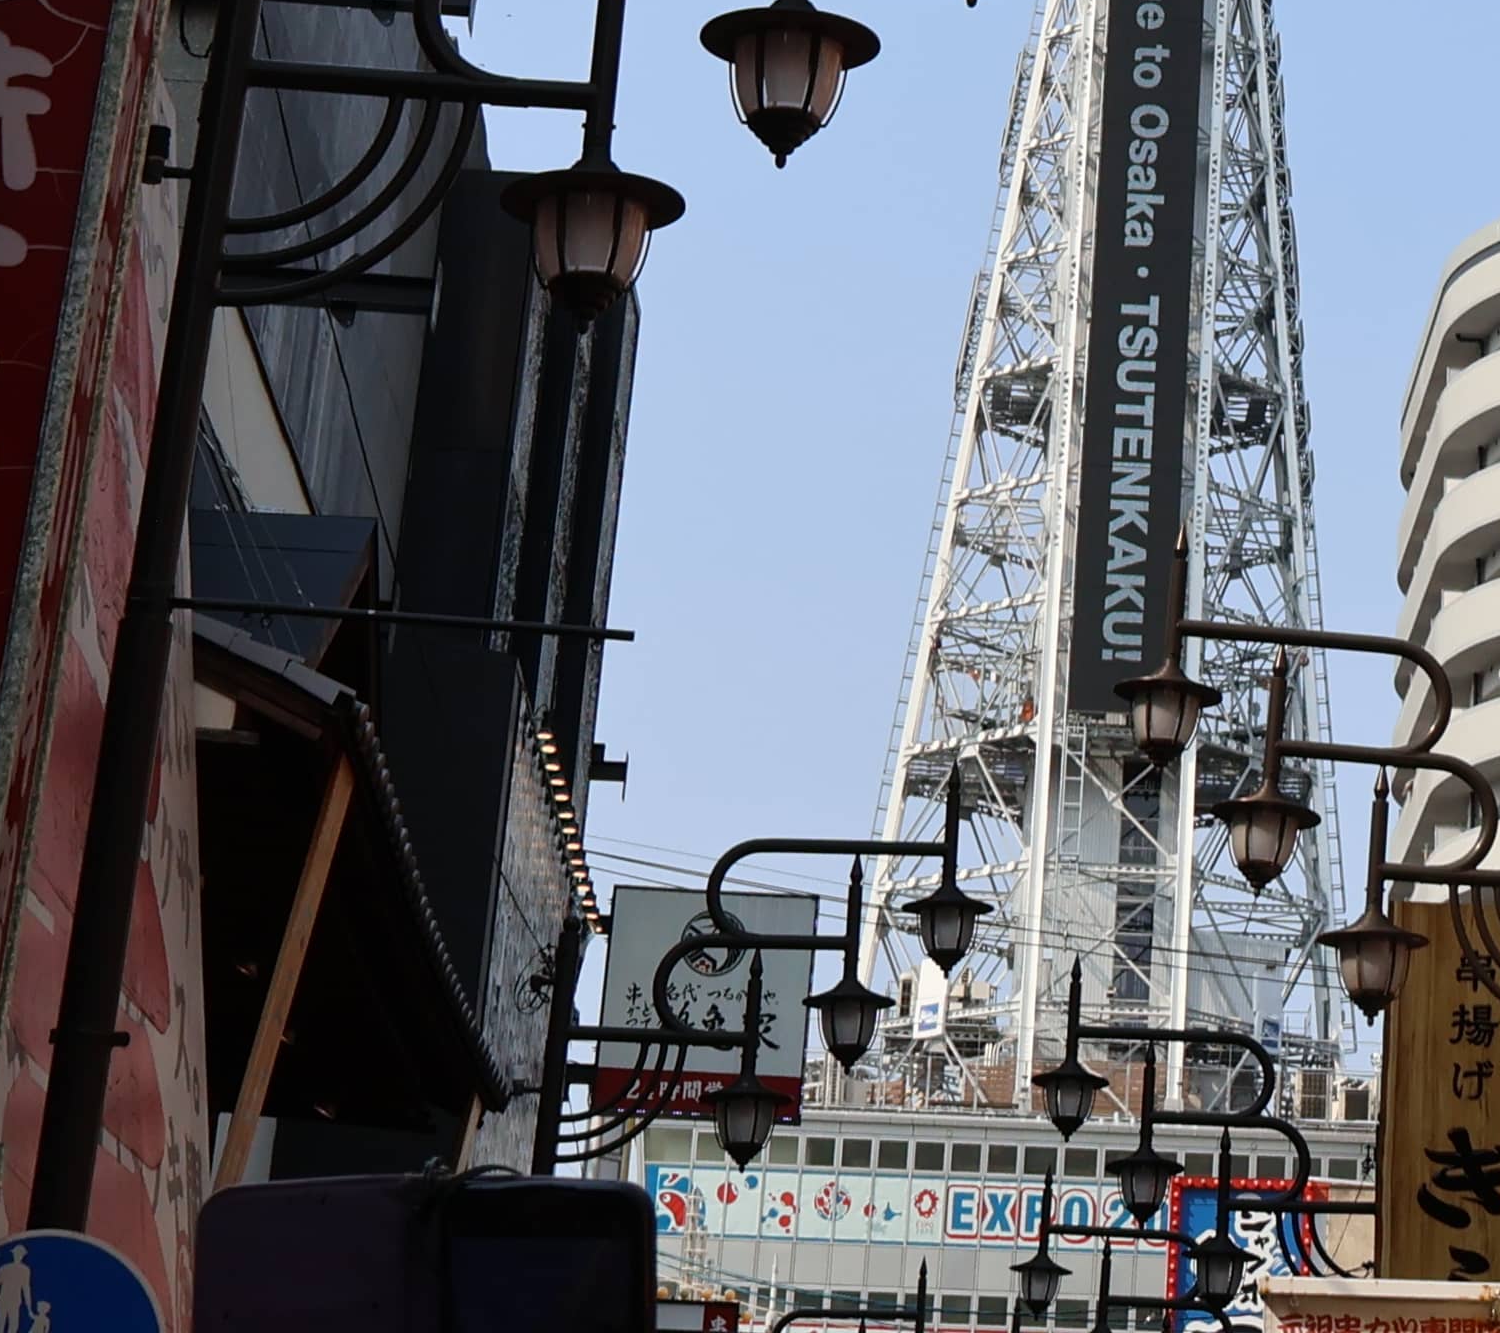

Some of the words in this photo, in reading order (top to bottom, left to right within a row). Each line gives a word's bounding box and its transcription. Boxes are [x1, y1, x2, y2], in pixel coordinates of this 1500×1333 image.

[1133, 44, 1170, 89] to
[1124, 103, 1170, 247] Osaka
[1101, 294, 1160, 662] TSUTENKAKU!
[1450, 950, 1498, 1100] 串揚げ
[948, 1189, 1095, 1240] EXPO
